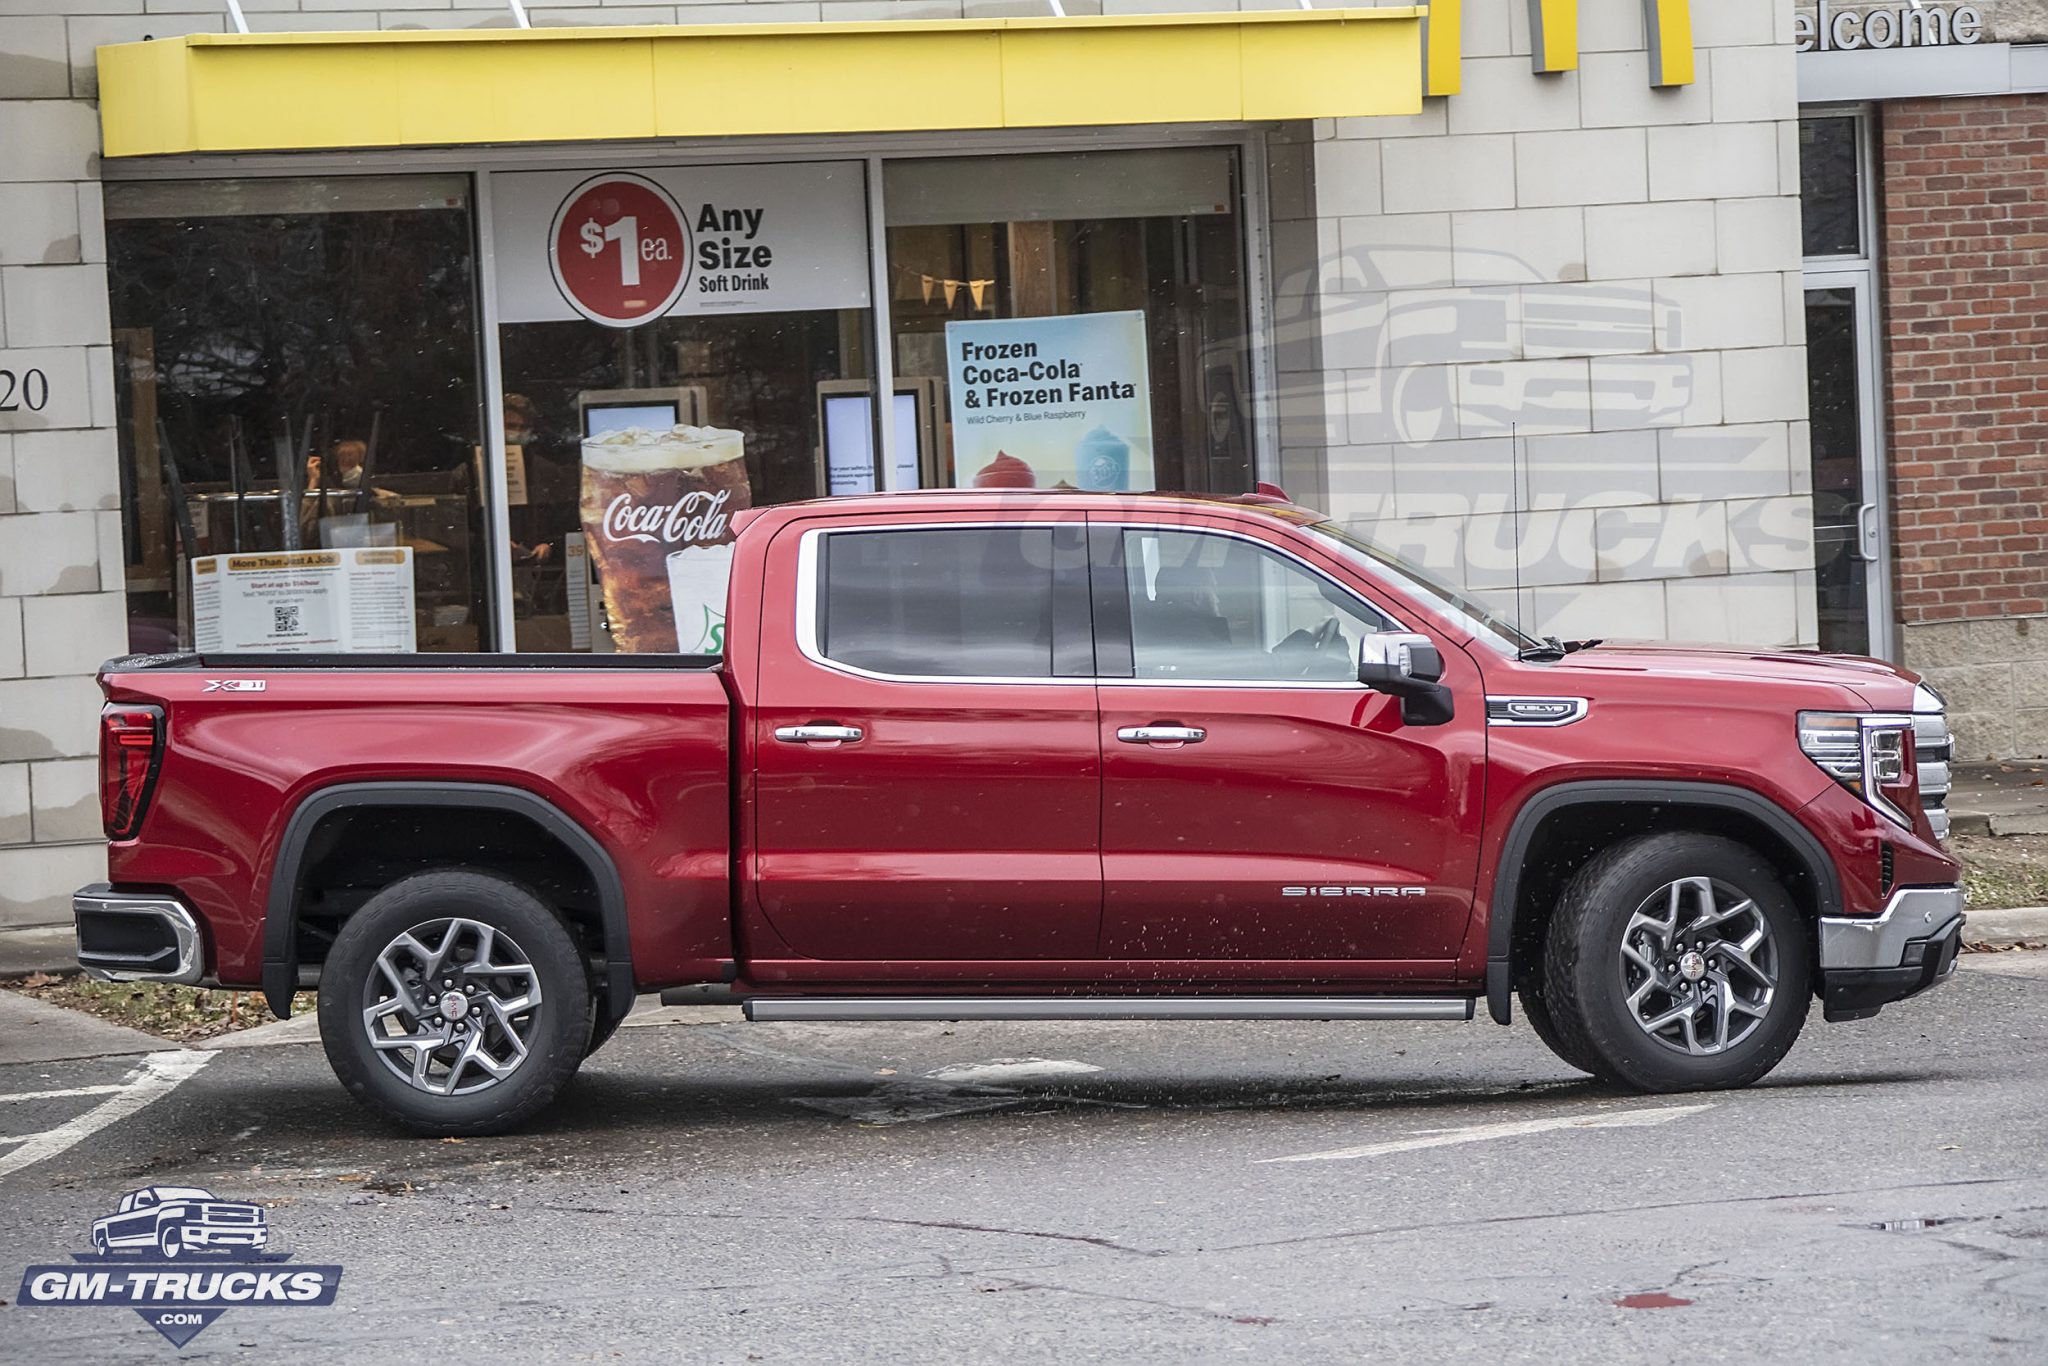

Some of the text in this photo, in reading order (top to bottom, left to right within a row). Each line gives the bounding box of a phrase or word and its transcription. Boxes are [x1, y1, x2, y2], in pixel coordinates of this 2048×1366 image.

[696, 203, 764, 240] Any
[579, 215, 673, 287] $1 ea.
[698, 237, 772, 271] Size
[699, 272, 770, 293] Soft Drink
[961, 341, 1038, 361] Frozen
[962, 358, 1081, 385] Coca-Cola
[0, 368, 49, 411] 20
[964, 380, 1136, 409] & Frozen Fanta
[966, 408, 1087, 425] Wild Cherry & Blue Raspberry
[602, 488, 731, 544] Coca-Cola
[232, 559, 257, 568] More
[259, 557, 282, 567] Than
[283, 556, 305, 566] Just
[307, 556, 314, 565] A
[1281, 886, 1427, 897] SIERRA
